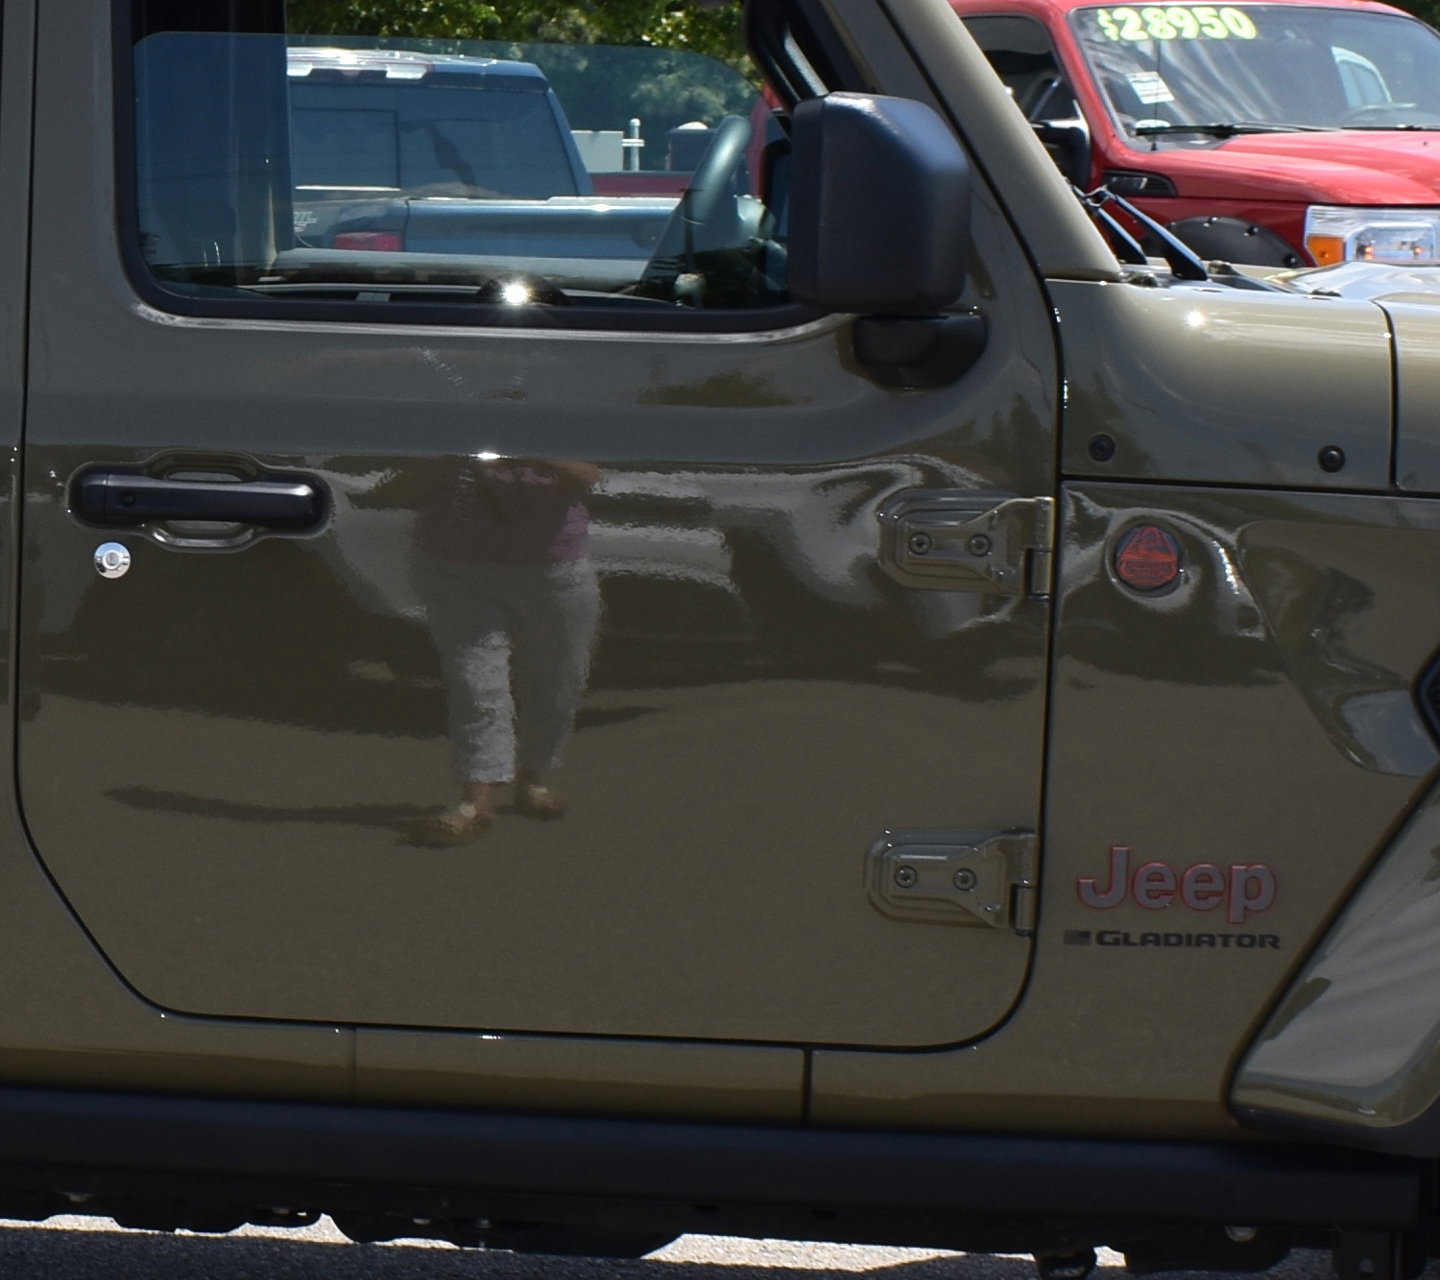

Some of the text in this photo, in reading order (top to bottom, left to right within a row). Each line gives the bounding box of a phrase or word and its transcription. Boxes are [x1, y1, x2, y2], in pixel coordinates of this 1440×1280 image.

[1097, 6, 1257, 42] $28950
[1076, 846, 1278, 925] Jeep
[1096, 930, 1282, 950] GLADIATOR
